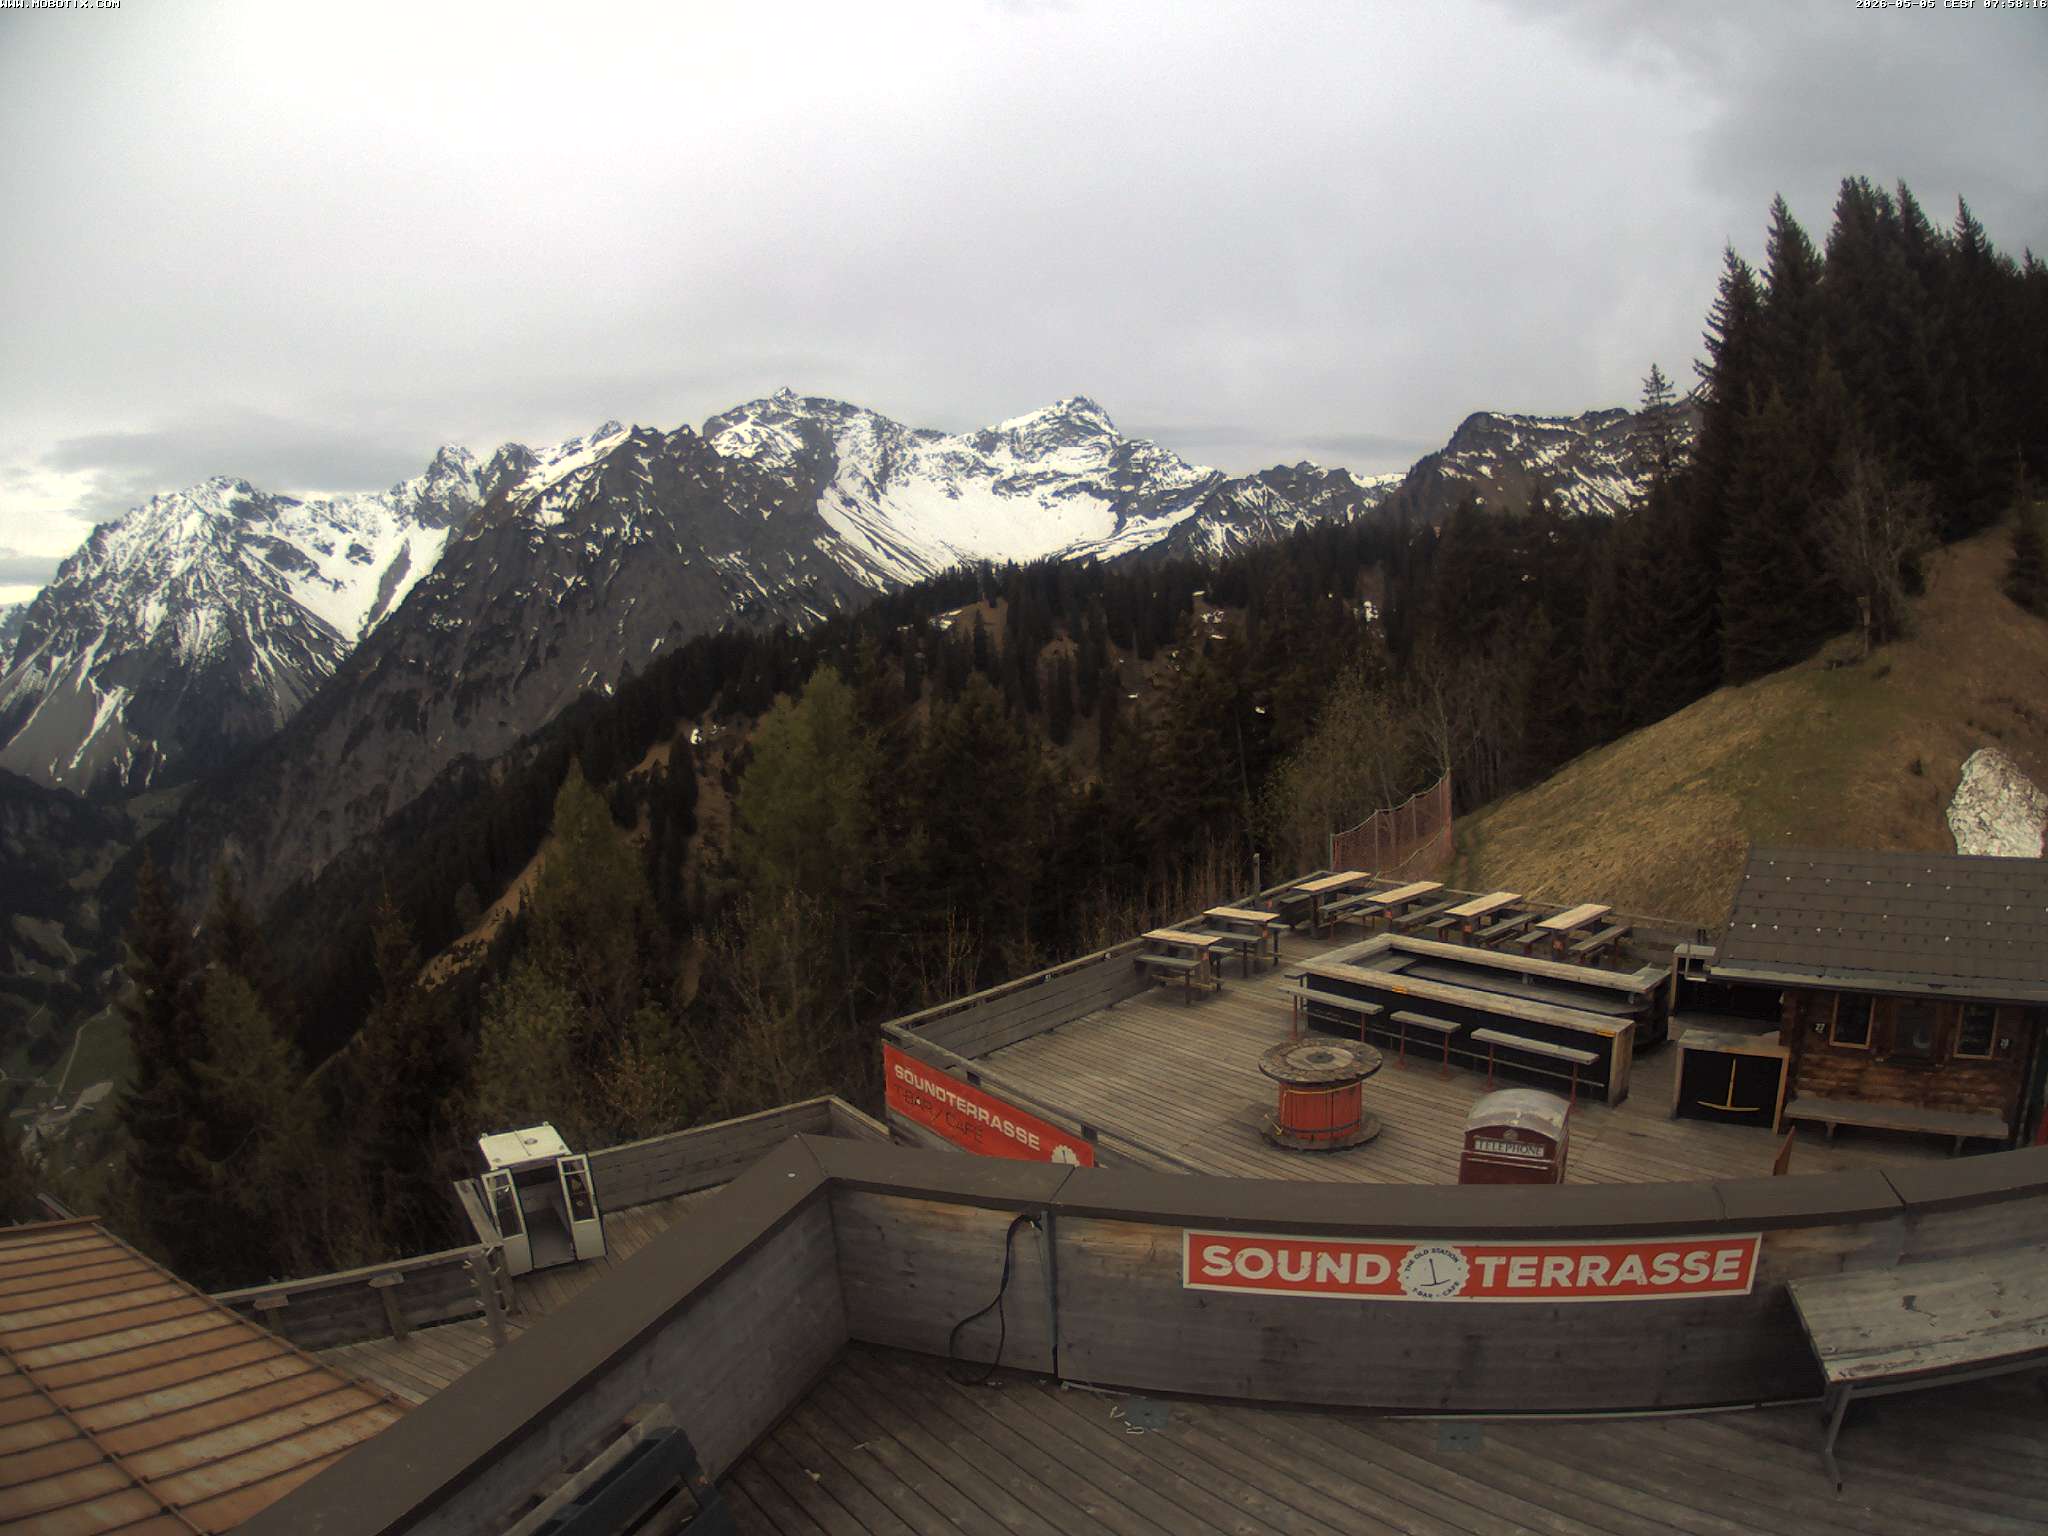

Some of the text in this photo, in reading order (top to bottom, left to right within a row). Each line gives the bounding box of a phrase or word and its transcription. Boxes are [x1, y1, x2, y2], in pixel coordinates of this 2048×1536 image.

[894, 1064, 1041, 1151] SOUNDTERRASSE
[1476, 1141, 1542, 1155] TELEPHONE
[1201, 1245, 1744, 1288] SOUND TERRASSE
[1414, 1249, 1429, 1259] OLD
[1431, 1247, 1459, 1263] STATION
